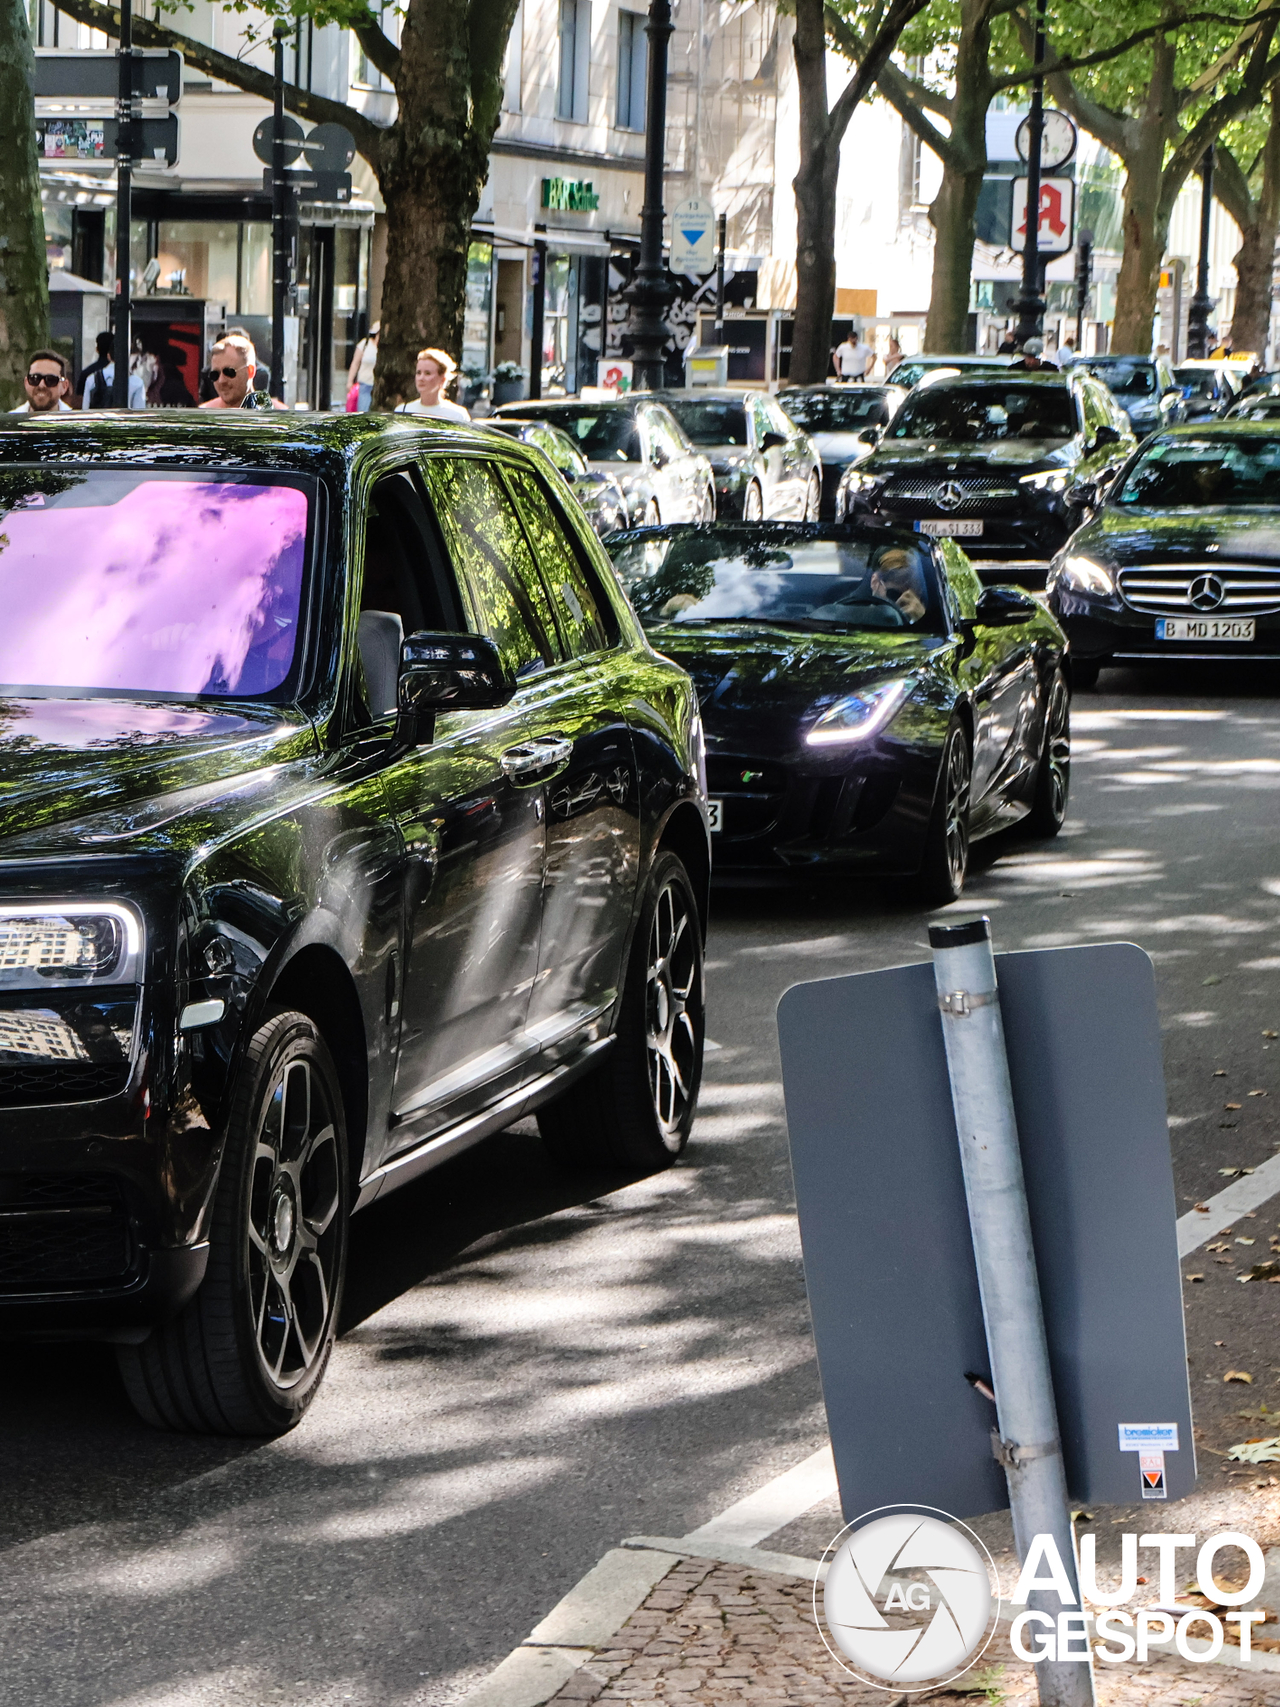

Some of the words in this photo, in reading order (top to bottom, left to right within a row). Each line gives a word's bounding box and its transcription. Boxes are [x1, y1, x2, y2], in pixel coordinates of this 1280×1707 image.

[688, 201, 699, 211] 13
[962, 523, 981, 535] 333
[1166, 622, 1176, 637] B
[1186, 623, 1208, 638] MD
[1211, 621, 1253, 638] 1203
